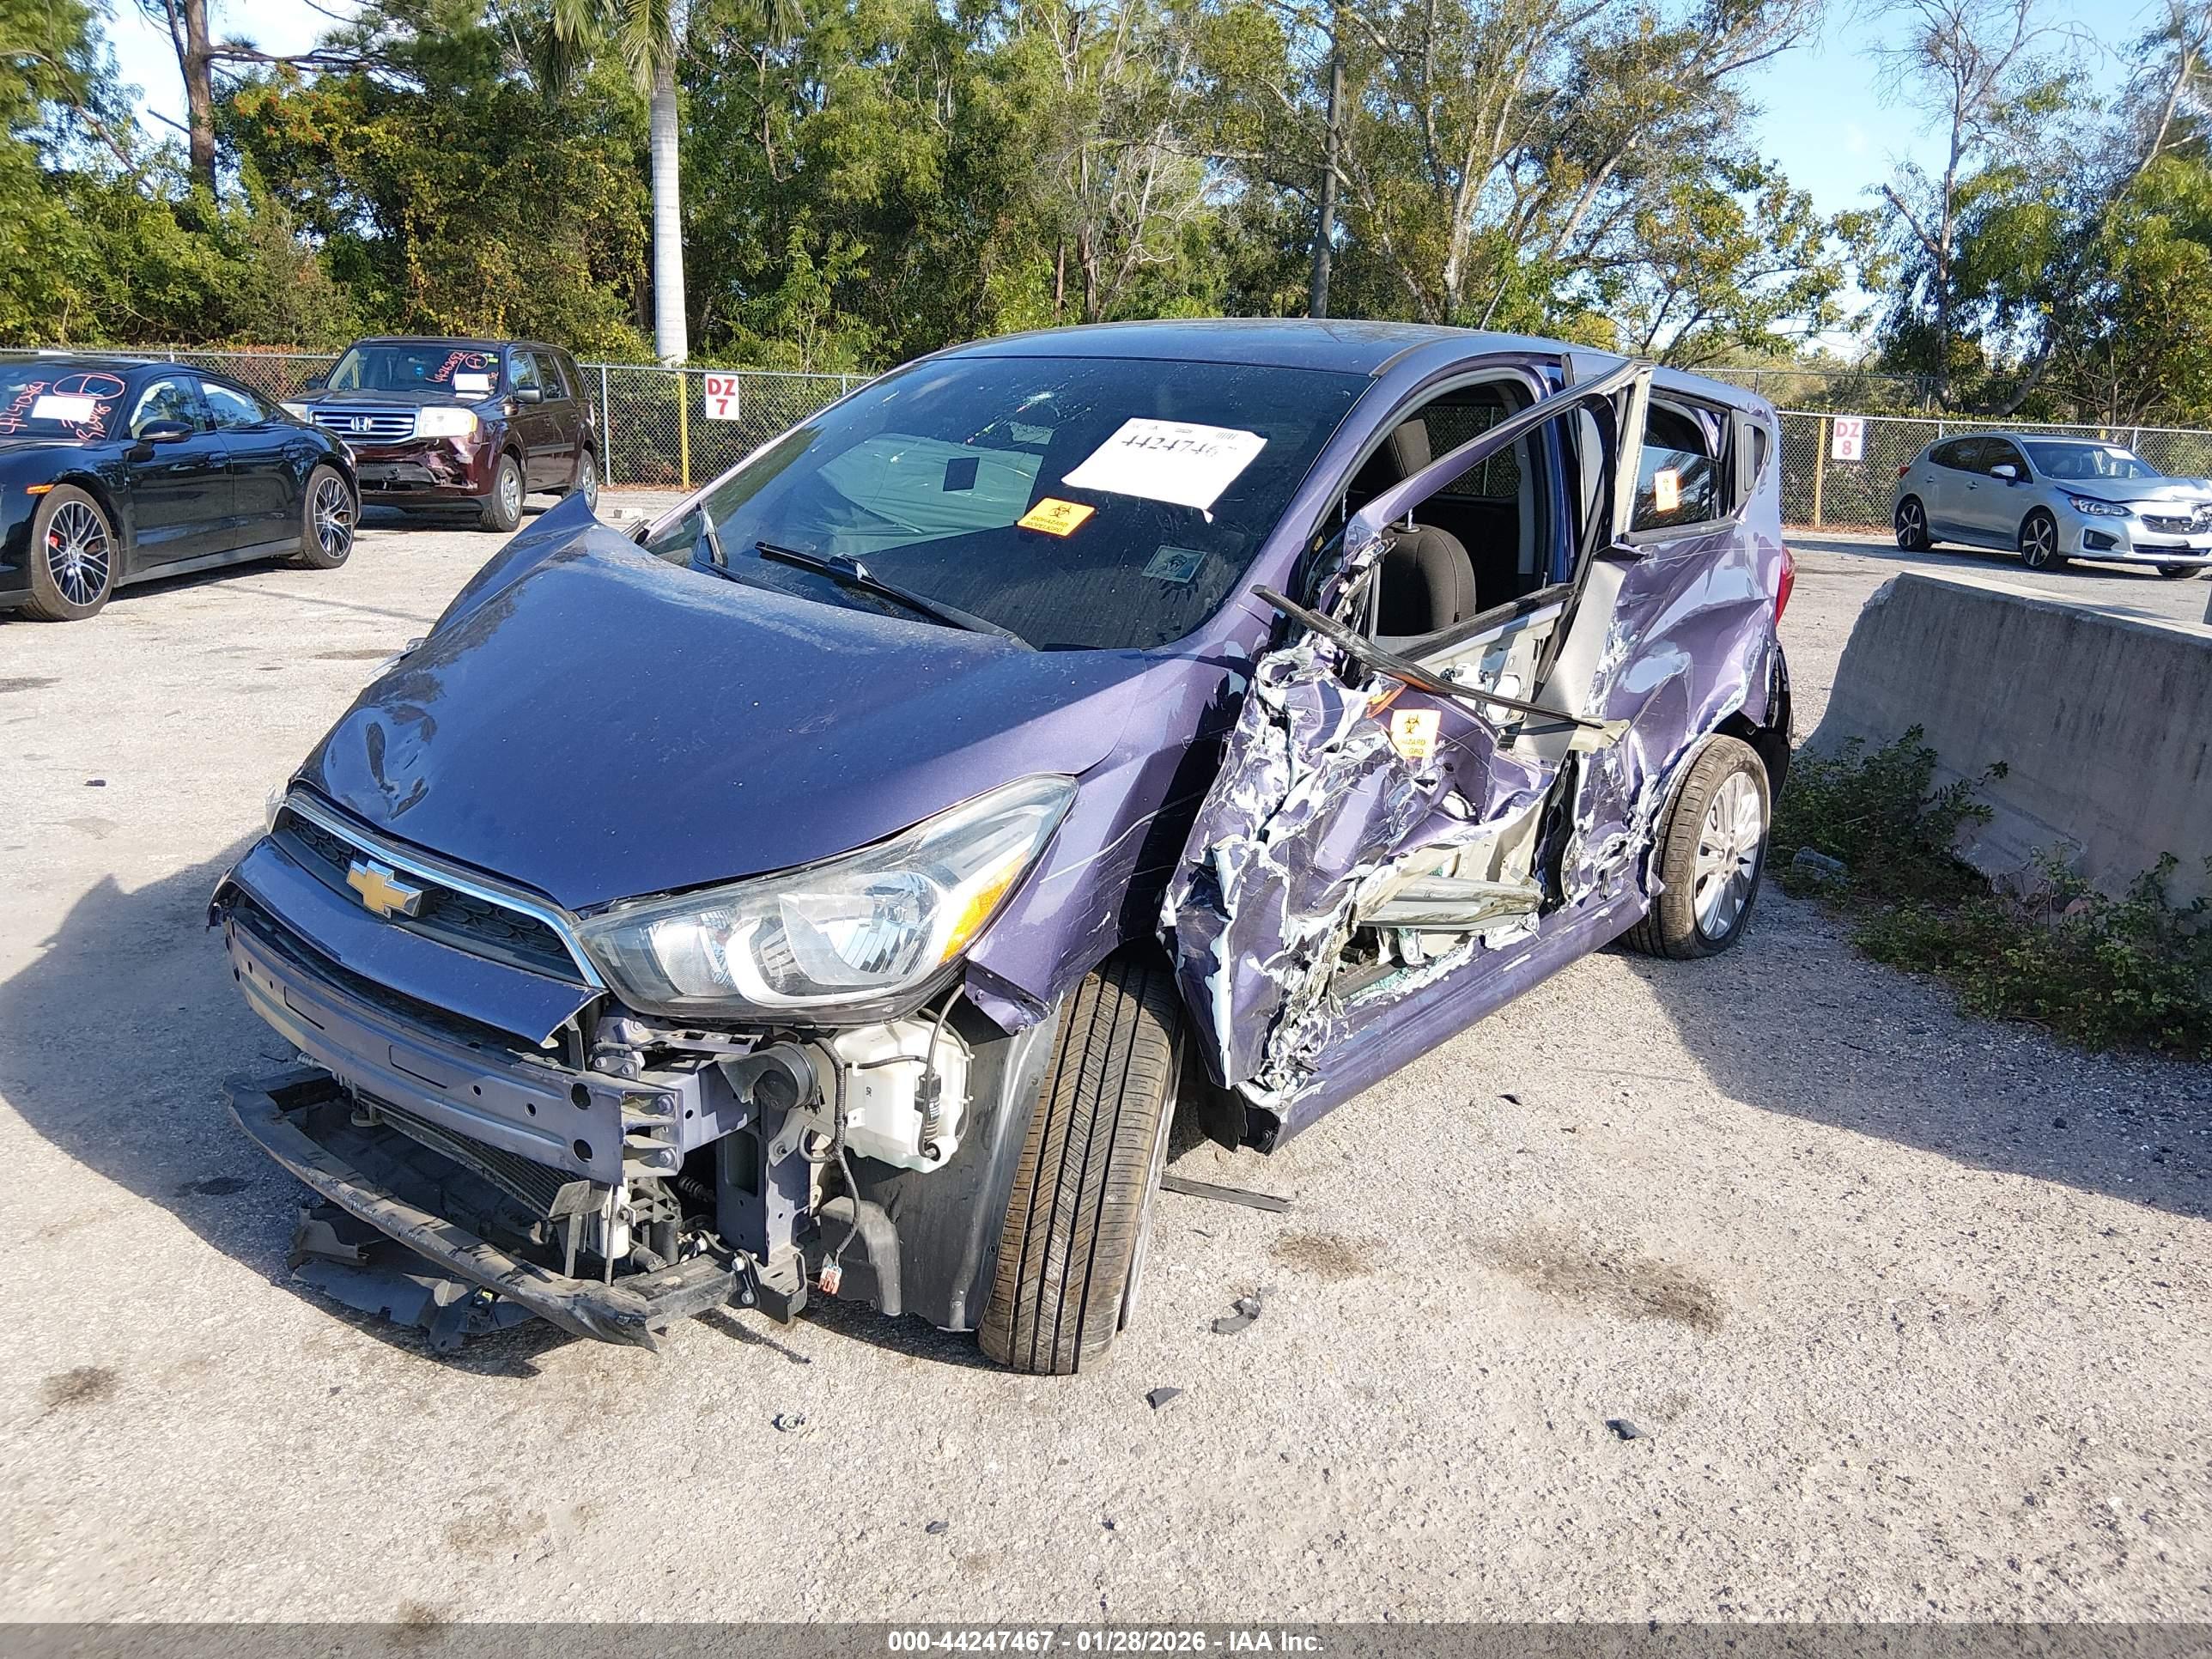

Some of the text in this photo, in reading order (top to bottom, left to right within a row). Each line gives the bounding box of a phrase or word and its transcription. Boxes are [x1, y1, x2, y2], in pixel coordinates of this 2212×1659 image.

[708, 378, 736, 396] DZ
[715, 398, 729, 416] 7
[1835, 422, 1860, 438] DZ
[1121, 434, 1237, 458] 4424746
[1842, 440, 1852, 456] 8
